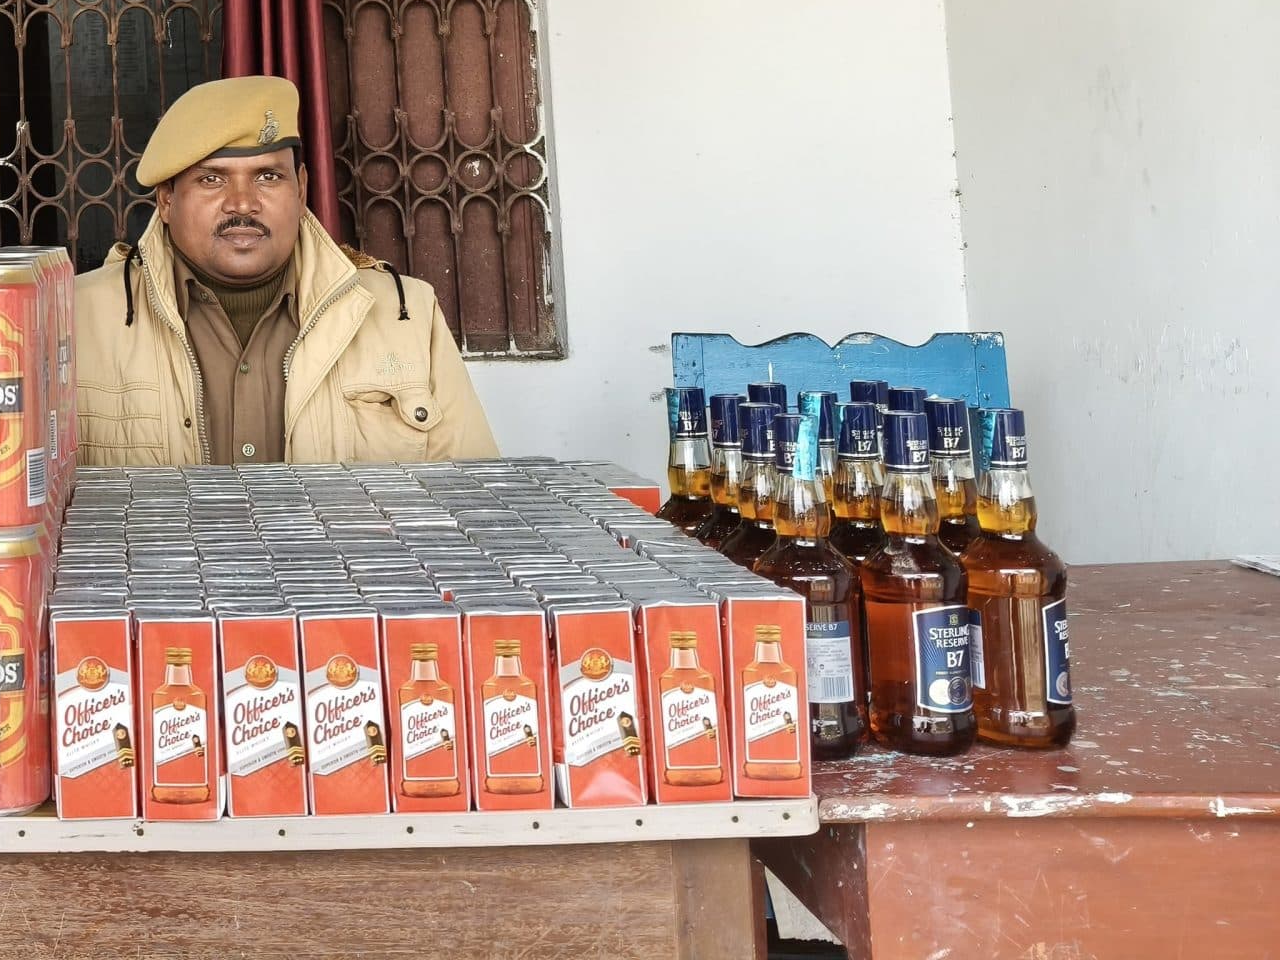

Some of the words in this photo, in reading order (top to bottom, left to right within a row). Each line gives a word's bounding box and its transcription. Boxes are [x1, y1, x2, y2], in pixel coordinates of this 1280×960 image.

[912, 451, 926, 462] B7
[1012, 447, 1026, 458] B7
[806, 623, 827, 632] SERVE
[946, 650, 964, 668] B7
[64, 689, 126, 727] Officer's
[233, 688, 295, 725] Officer's
[315, 687, 376, 724] Officer's
[570, 679, 630, 717] Officer's
[668, 694, 710, 719] Officer's
[750, 688, 792, 713] Officer's
[159, 711, 201, 735] Officer's
[407, 706, 448, 730] Officer's
[490, 702, 531, 726] Officer's
[568, 708, 616, 737] Choice
[667, 712, 700, 732] Choice
[749, 707, 782, 726] Choice
[62, 719, 111, 747] Choice
[158, 730, 191, 749] Choice
[231, 717, 280, 746] Choice
[313, 716, 362, 745] Choice
[406, 725, 439, 744] Choice
[489, 722, 522, 741] Choice
